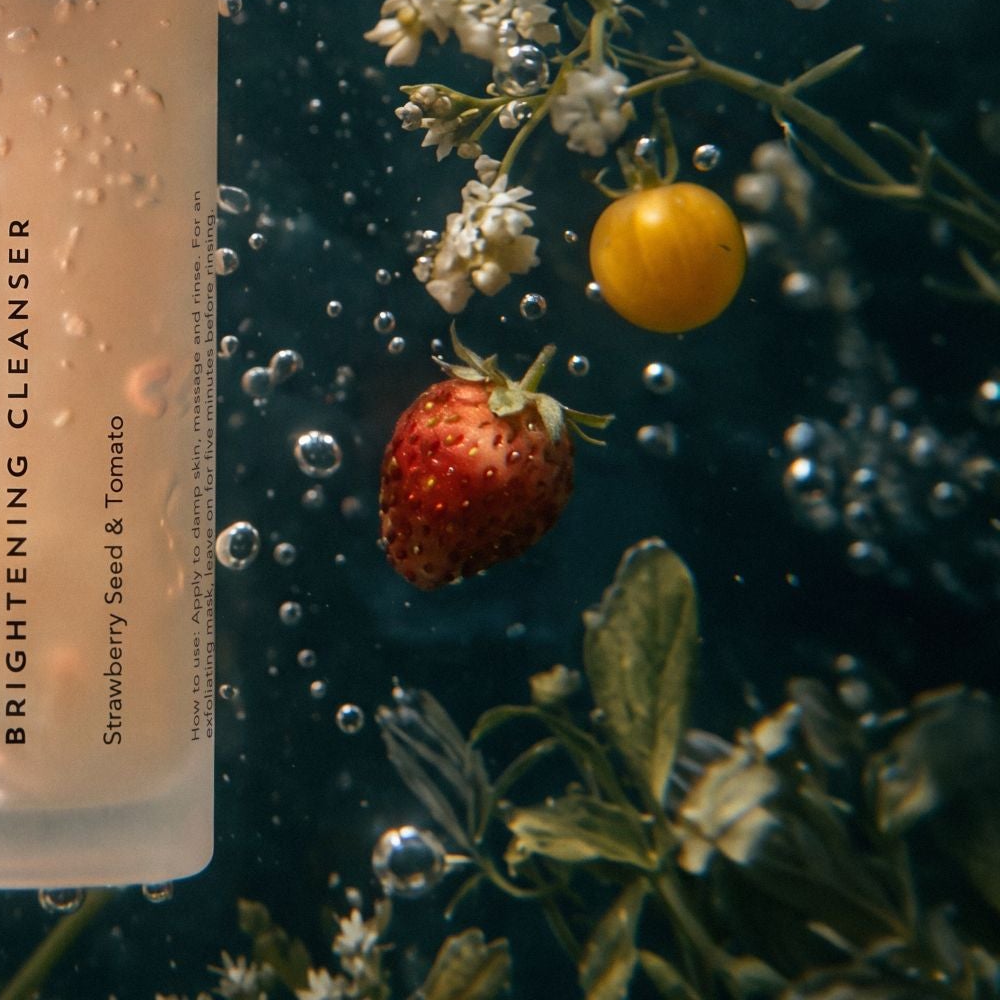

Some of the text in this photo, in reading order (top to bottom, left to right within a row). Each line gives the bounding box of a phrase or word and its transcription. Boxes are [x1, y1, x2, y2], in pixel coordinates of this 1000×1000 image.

[4, 220, 30, 744] BRIGHTENING CLEANSER
[102, 416, 128, 745] Strawberry Seed & Tomato
[189, 190, 204, 742] How to use: Apply to damp skin, massage and rinse. For an
[203, 207, 216, 740] exfoliating mask, leave on for five minutes before rinsing.
